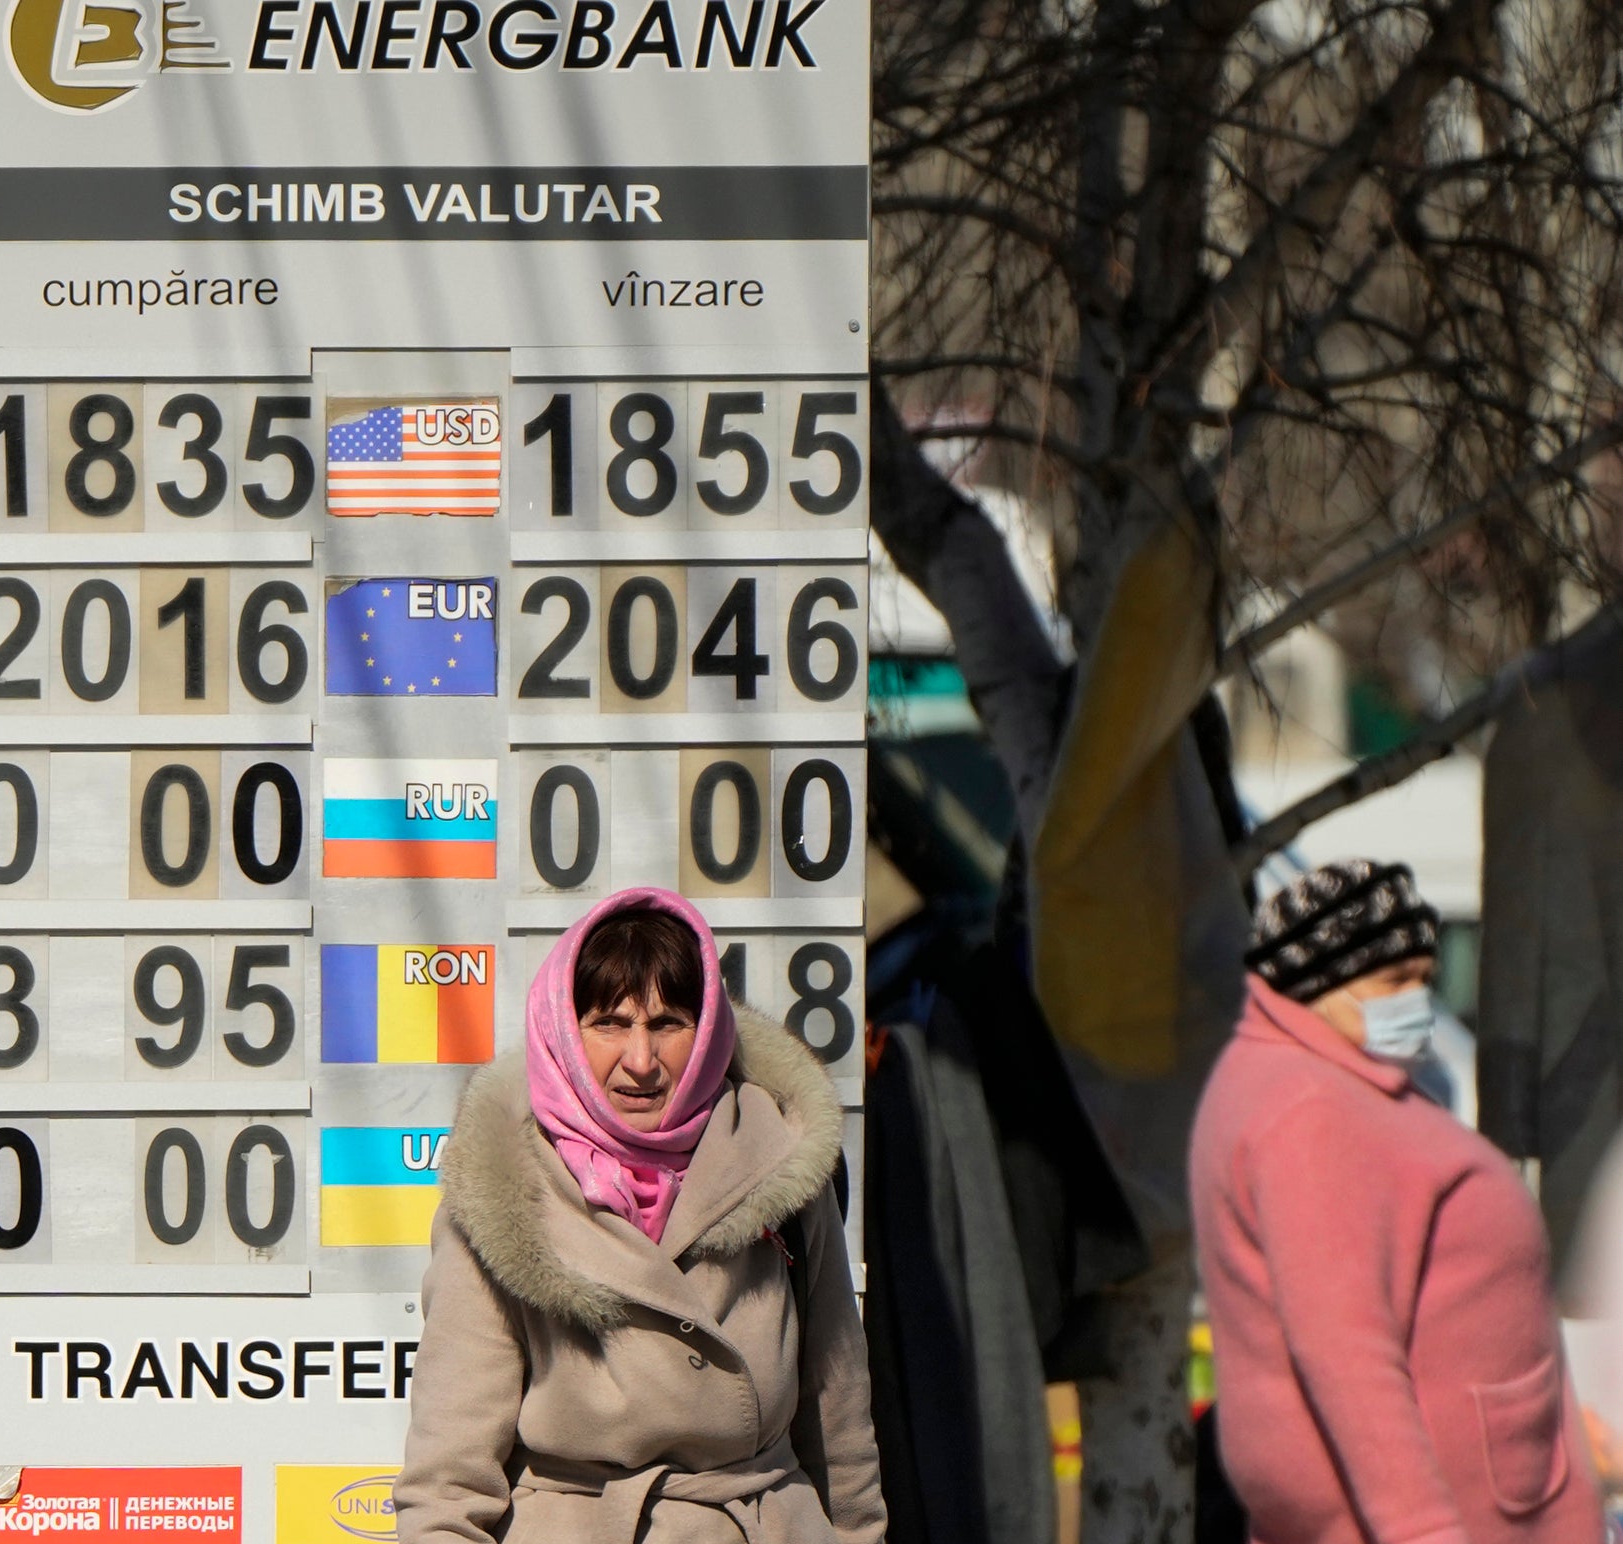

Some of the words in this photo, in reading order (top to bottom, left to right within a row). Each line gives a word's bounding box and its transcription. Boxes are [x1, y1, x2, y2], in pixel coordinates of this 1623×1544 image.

[249, 0, 824, 70] ENERGBANK
[169, 184, 385, 222] SCHIMB
[403, 184, 662, 222] VALUTAR
[42, 271, 278, 315] cumpărare
[602, 271, 764, 307] vînzare
[416, 408, 499, 445] USD
[524, 392, 861, 517] 1855
[408, 584, 493, 619] EUR
[518, 576, 858, 702] 2046
[406, 783, 490, 821] RUR
[530, 765, 599, 890] 0
[404, 951, 487, 984] RON
[21, 1493, 101, 1511] Золотая
[125, 1496, 235, 1514] ДЕНЕЖНЫЕ
[125, 1515, 234, 1533] ПЕРЕВОДЫ
